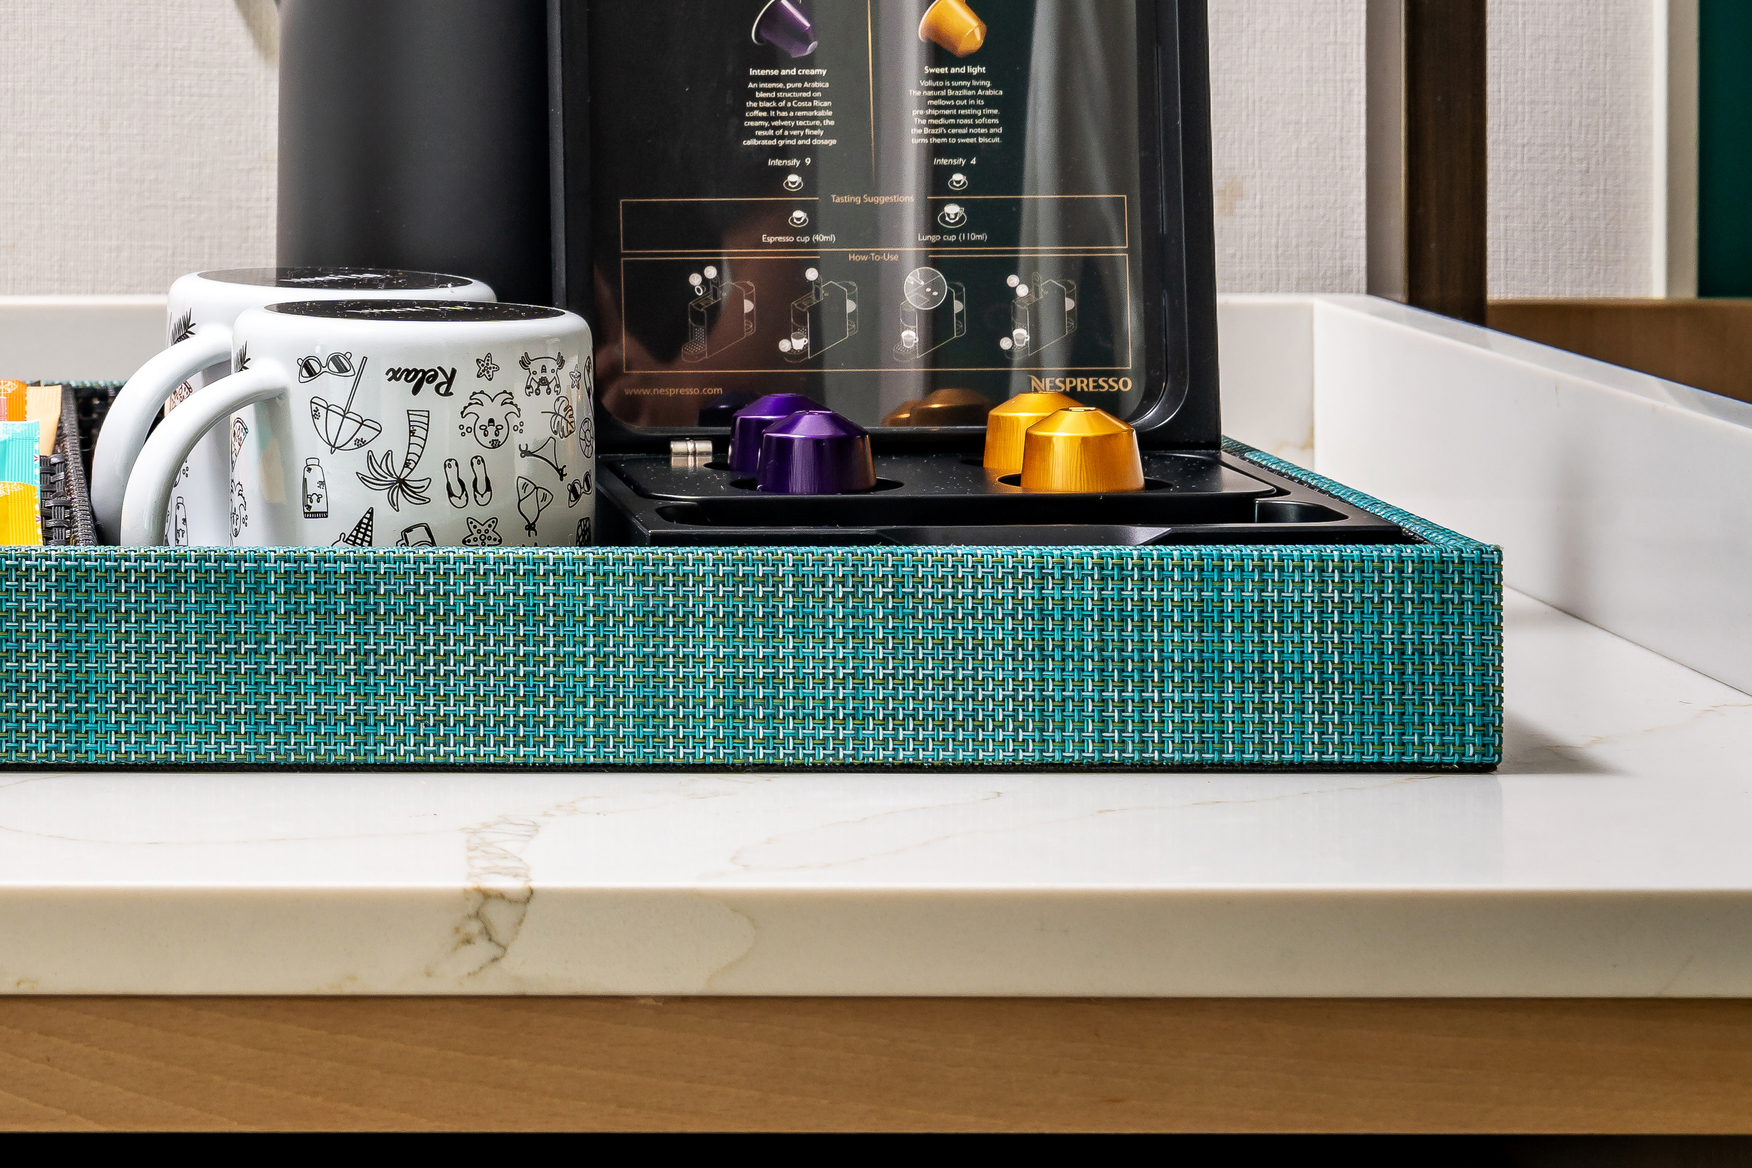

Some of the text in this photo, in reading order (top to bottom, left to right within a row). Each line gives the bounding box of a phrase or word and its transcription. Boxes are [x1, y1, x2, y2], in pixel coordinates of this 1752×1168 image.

[798, 68, 827, 76] creamy
[967, 66, 986, 75] light
[958, 108, 981, 116] resting
[744, 120, 770, 128] creamy,
[805, 129, 824, 137] finely
[778, 138, 796, 146] grind
[812, 138, 837, 146] dosage
[768, 159, 801, 167] Intensity
[933, 157, 976, 166] Intensity 4
[831, 194, 914, 203] Tasting Suggestions
[762, 234, 794, 243] Espresso
[812, 234, 836, 243] (40ml)
[918, 233, 941, 242] Lungo
[959, 233, 987, 242] (110ml)
[385, 366, 457, 397] Relax
[1029, 375, 1132, 392] NESPRESSO
[624, 387, 722, 397] www.nespresso.com
